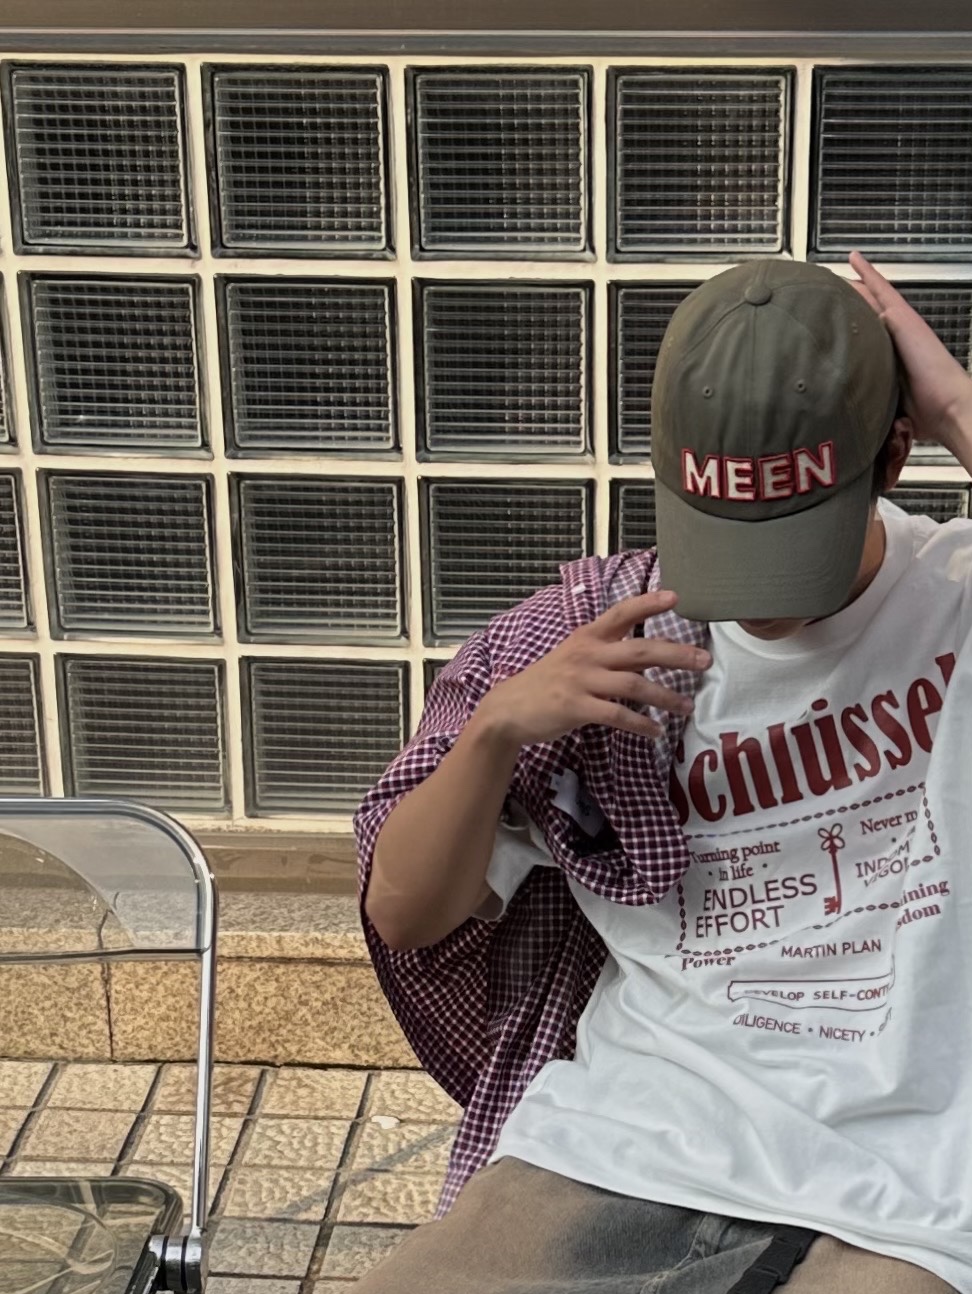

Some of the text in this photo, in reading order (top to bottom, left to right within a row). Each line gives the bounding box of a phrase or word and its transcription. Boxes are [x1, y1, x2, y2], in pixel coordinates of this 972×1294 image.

[681, 440, 836, 501] MEEN
[669, 652, 956, 826] chlüsse
[860, 815, 902, 835] Never
[741, 841, 781, 861] point
[730, 863, 754, 880] life
[703, 874, 818, 911] ENDLESS
[696, 905, 785, 938] EFFORT
[781, 939, 882, 958] MARTIN PLAN
[681, 956, 736, 971] Power
[819, 1025, 866, 1042] NICETY
